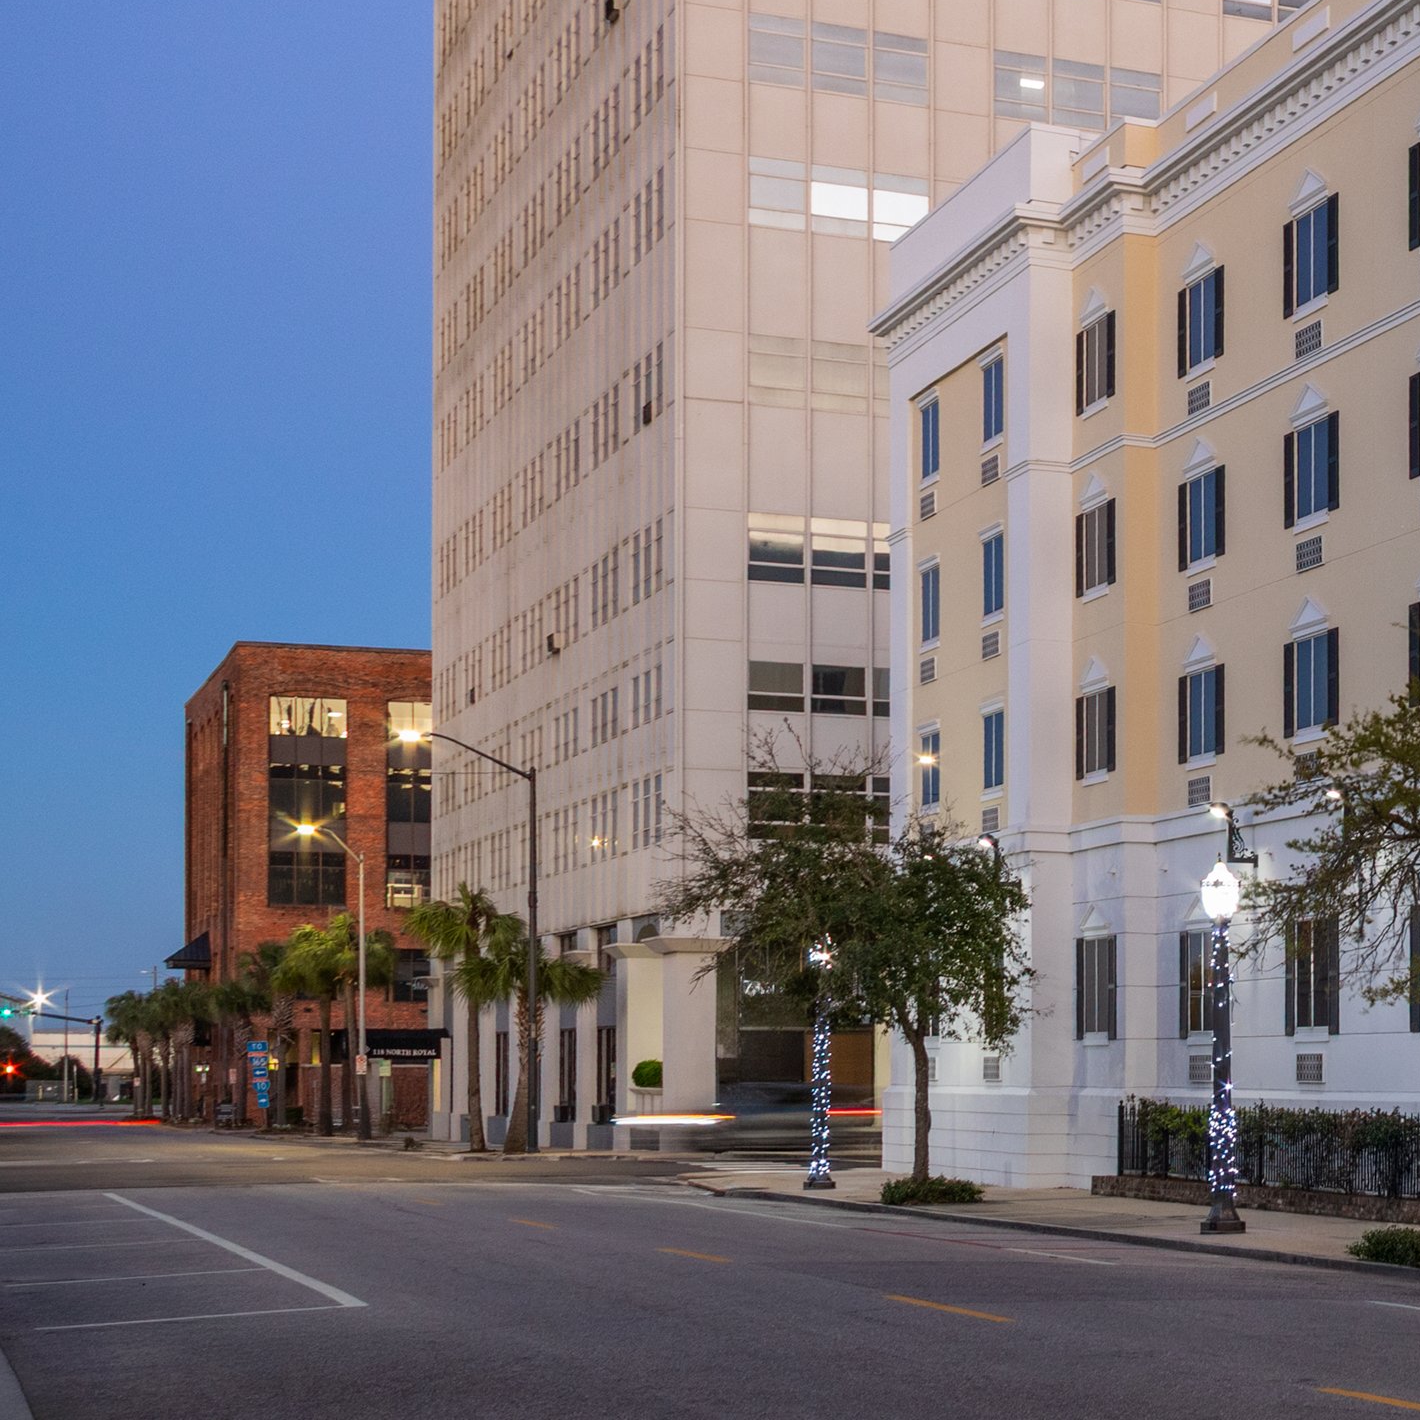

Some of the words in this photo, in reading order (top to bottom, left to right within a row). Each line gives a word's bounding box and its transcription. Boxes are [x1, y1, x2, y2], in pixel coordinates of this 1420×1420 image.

[386, 1048, 412, 1056] NORTH
[413, 1048, 437, 1056] ROYAL
[256, 1081, 267, 1091] 10
